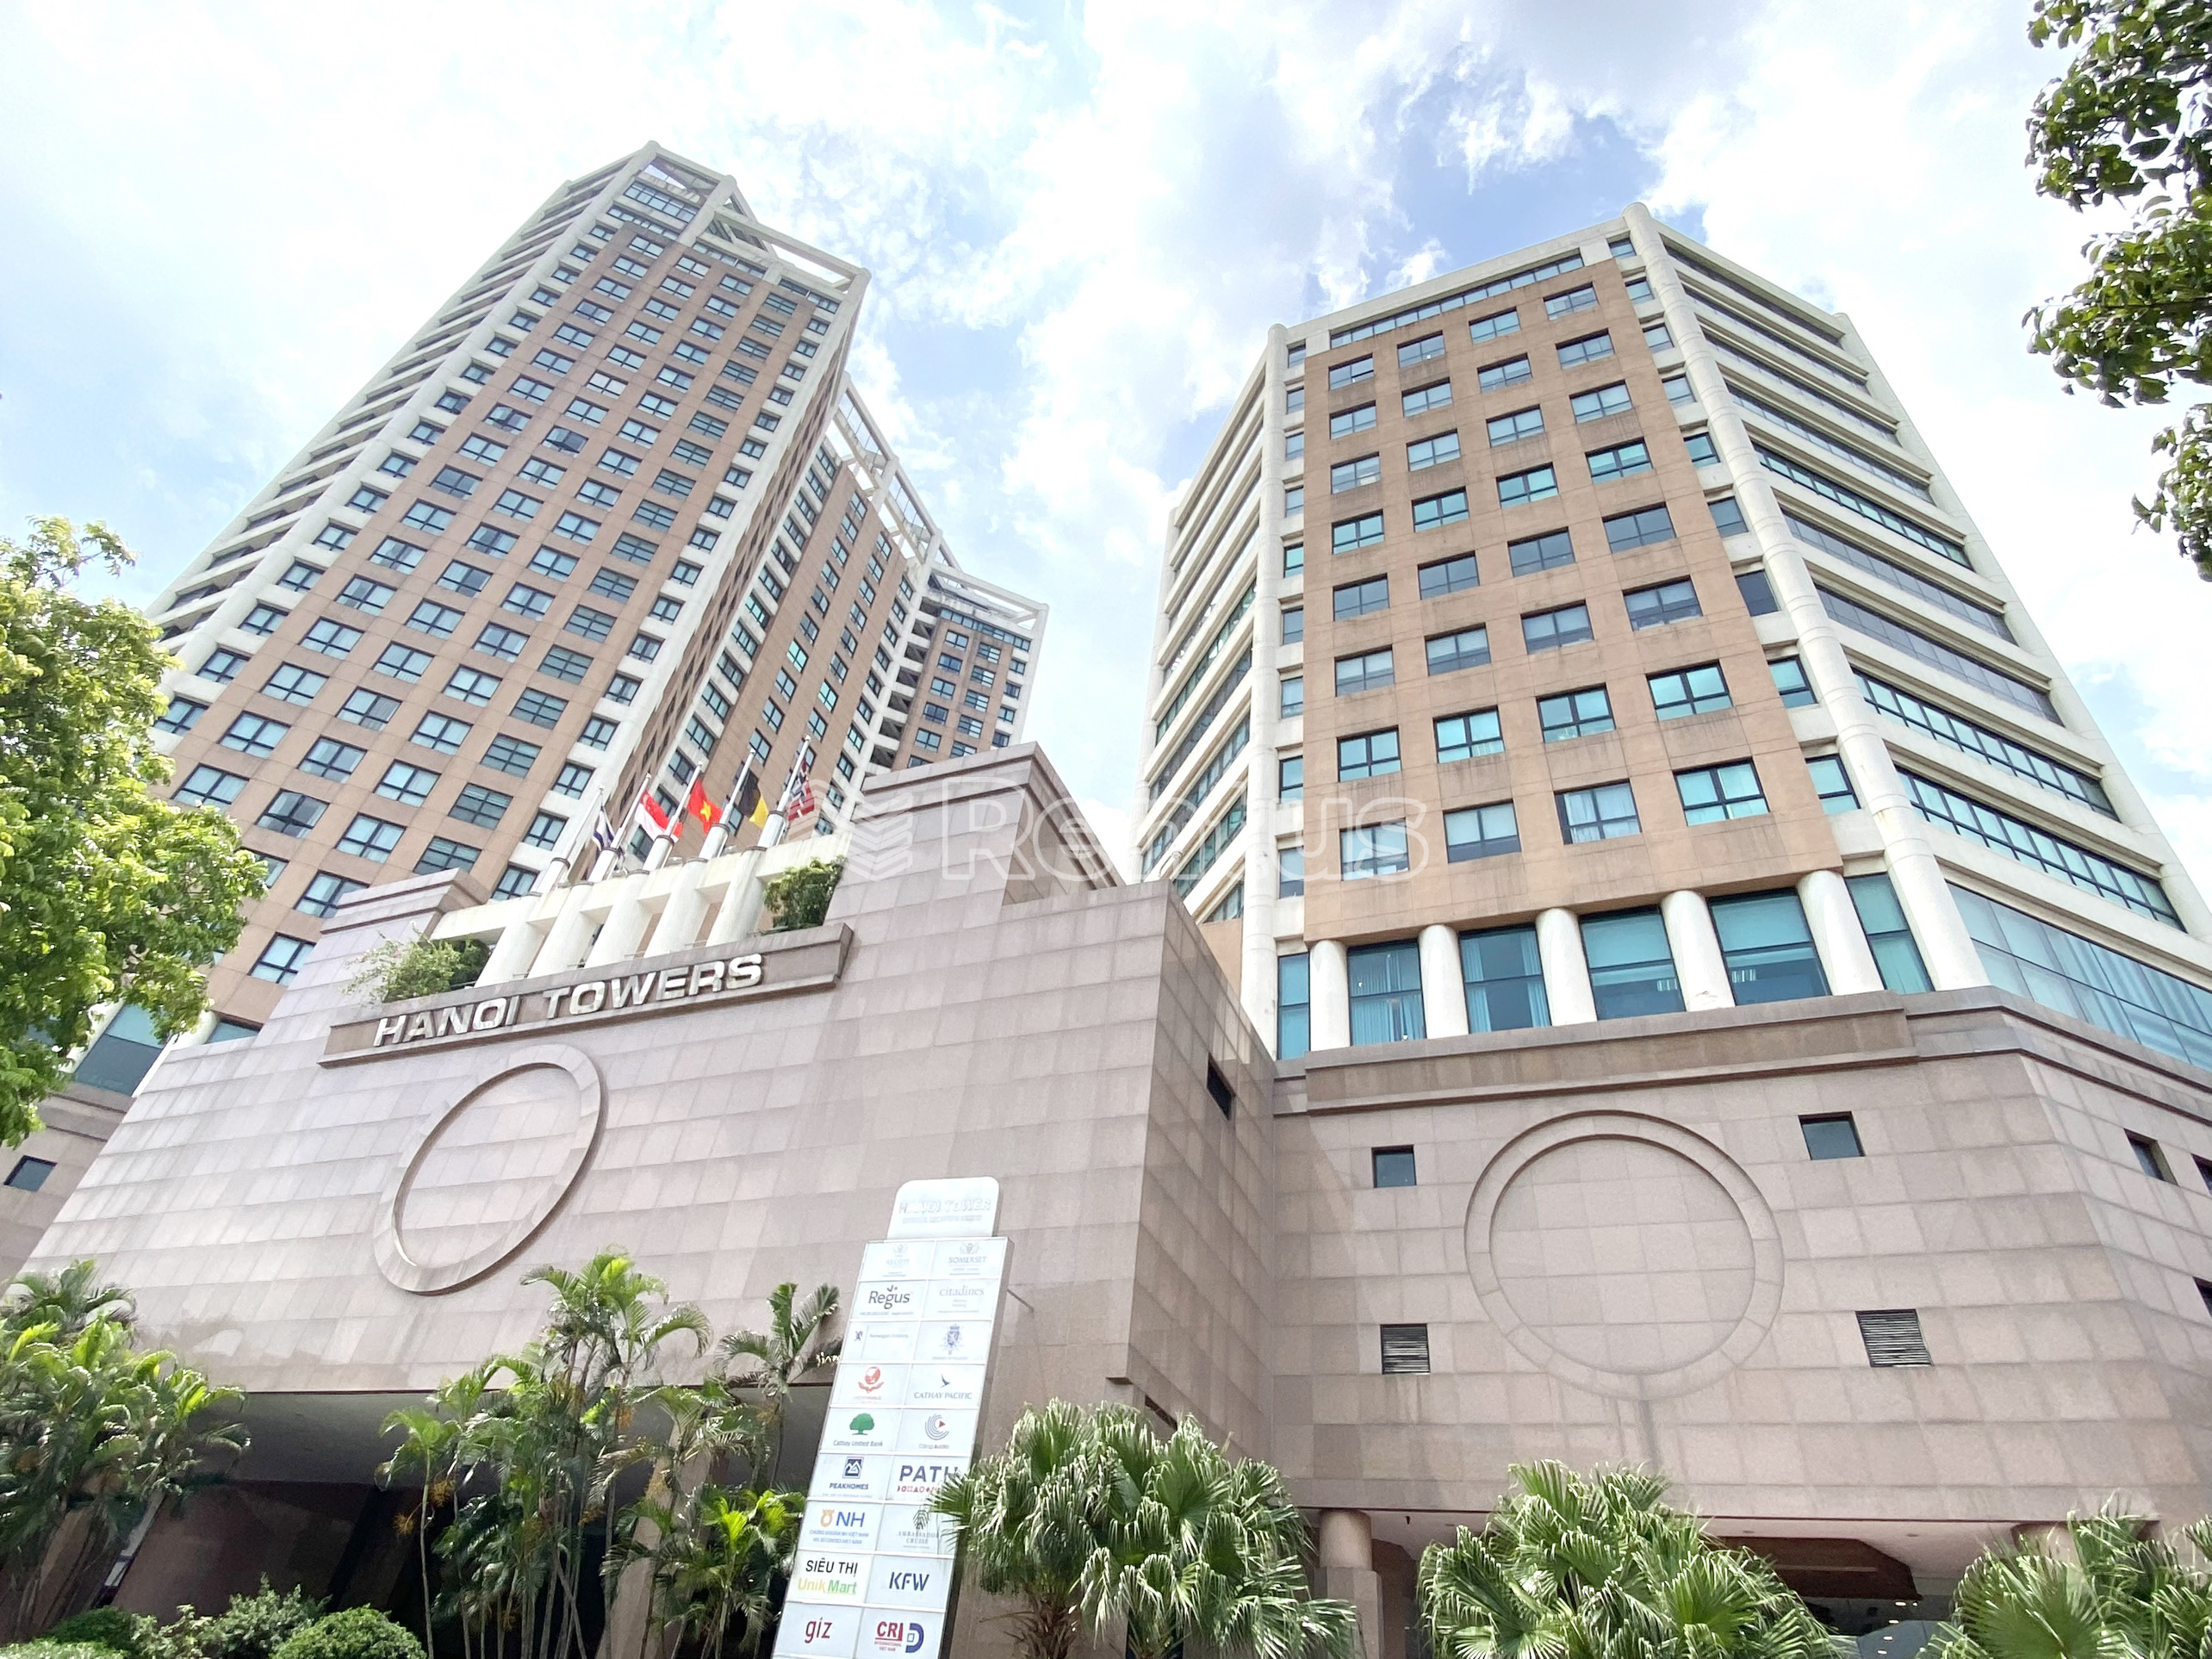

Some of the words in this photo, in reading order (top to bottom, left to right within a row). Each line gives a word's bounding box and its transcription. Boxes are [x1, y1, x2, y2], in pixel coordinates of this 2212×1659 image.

[373, 995, 519, 1047] HANOI
[544, 954, 763, 1021] TOWERS
[868, 1284, 910, 1309] Regus
[913, 1391, 943, 1400] CATHAY
[944, 1391, 973, 1400] PACIFIC
[805, 1557, 835, 1574] SIÊU
[838, 1562, 859, 1578] THỊ
[889, 1571, 930, 1592] KFW
[805, 1616, 833, 1643] giz
